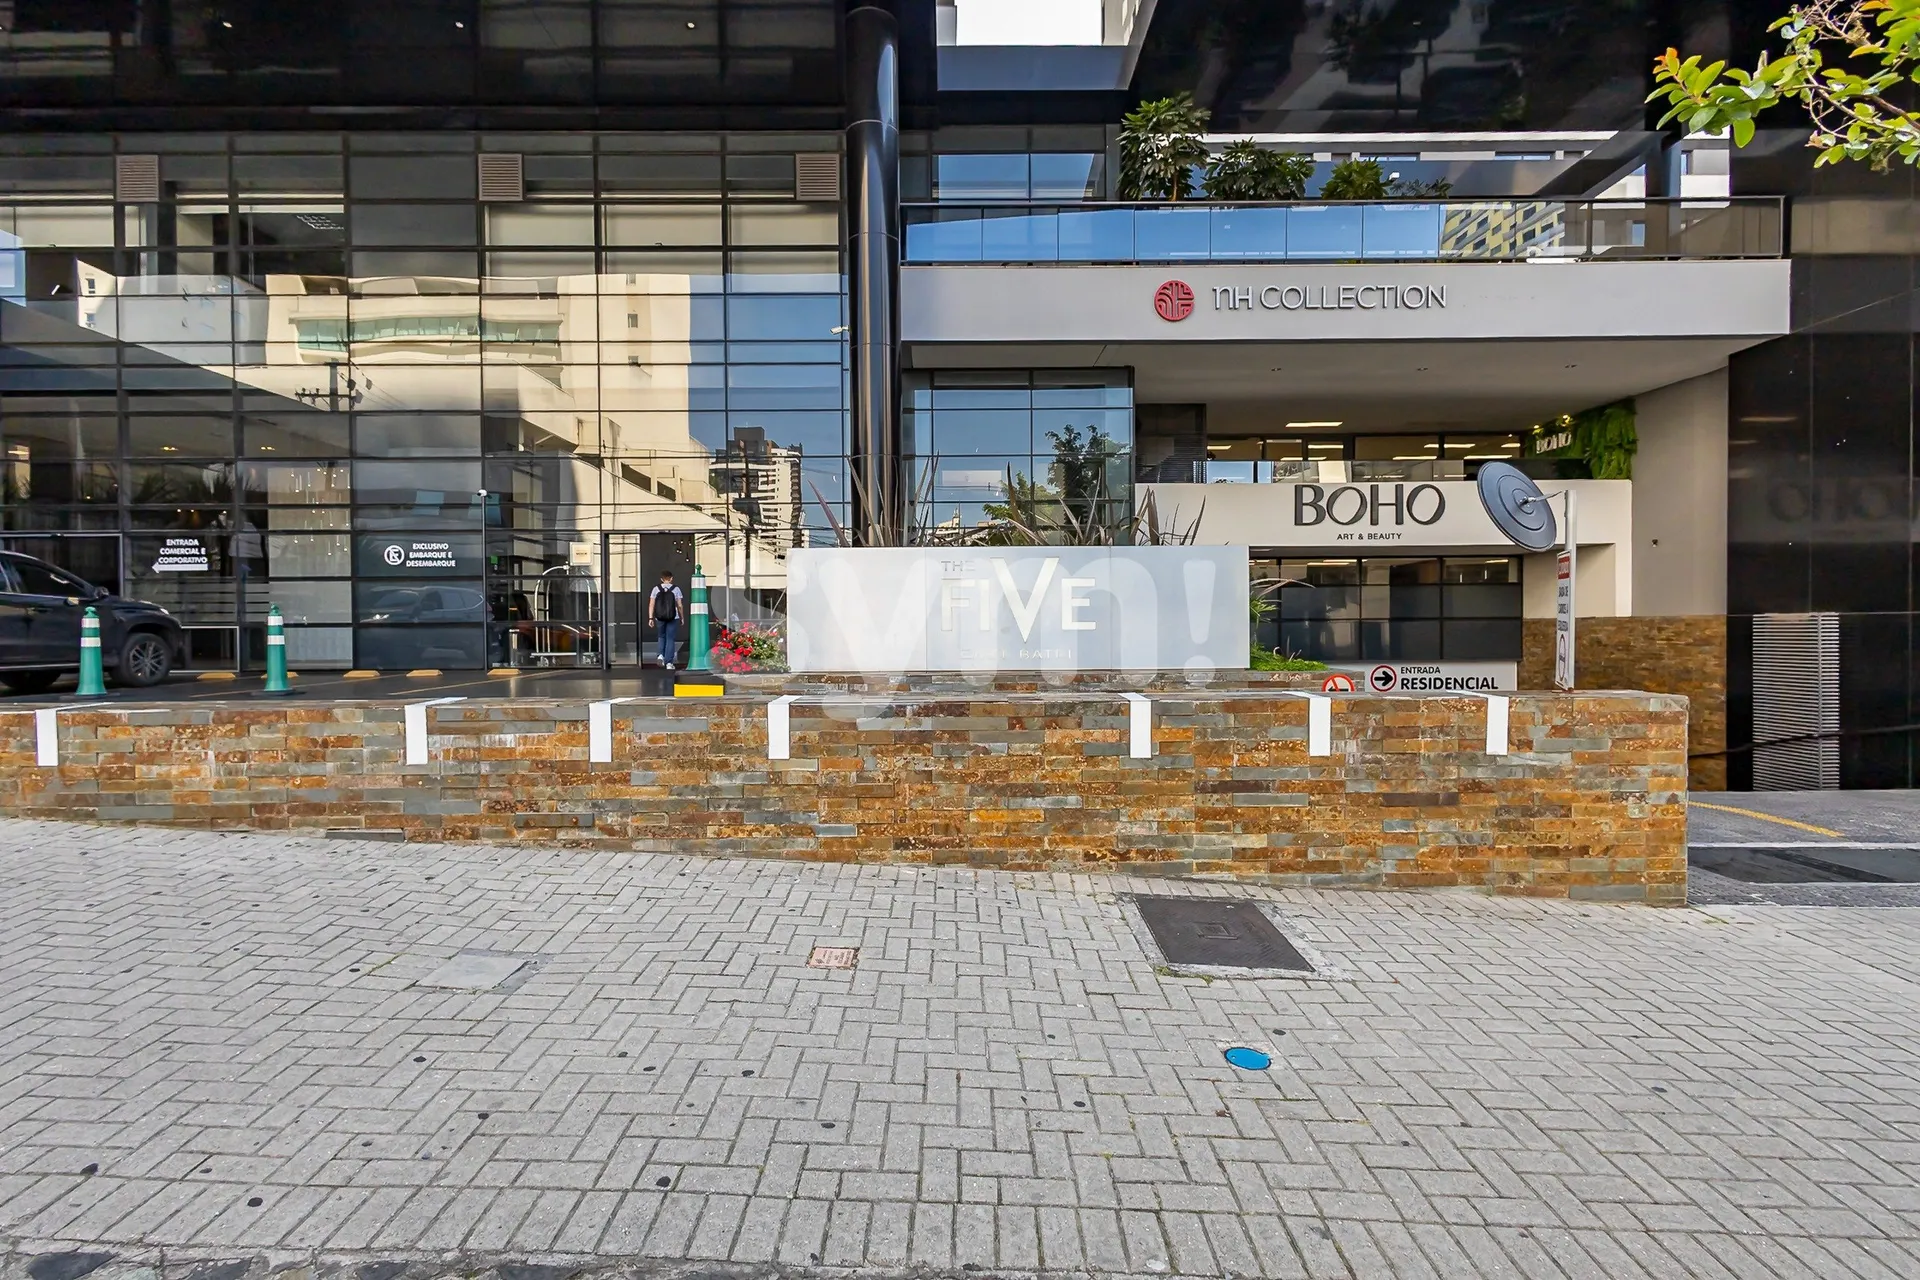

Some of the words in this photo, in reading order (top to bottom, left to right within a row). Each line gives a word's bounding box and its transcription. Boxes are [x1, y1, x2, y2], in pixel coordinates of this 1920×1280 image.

[1260, 285, 1447, 310] COLLECTION
[1294, 483, 1446, 526] BOHO
[159, 547, 200, 555] COMERCIAL
[201, 547, 206, 555] E
[409, 551, 447, 559] EMBARQUE
[447, 551, 453, 559] E
[158, 556, 208, 564] CORPORATIVO
[941, 560, 976, 572] THE
[941, 556, 1097, 643] FIVE
[1400, 666, 1441, 674] ENTRADA
[1400, 676, 1499, 690] RESIDENCIAL
